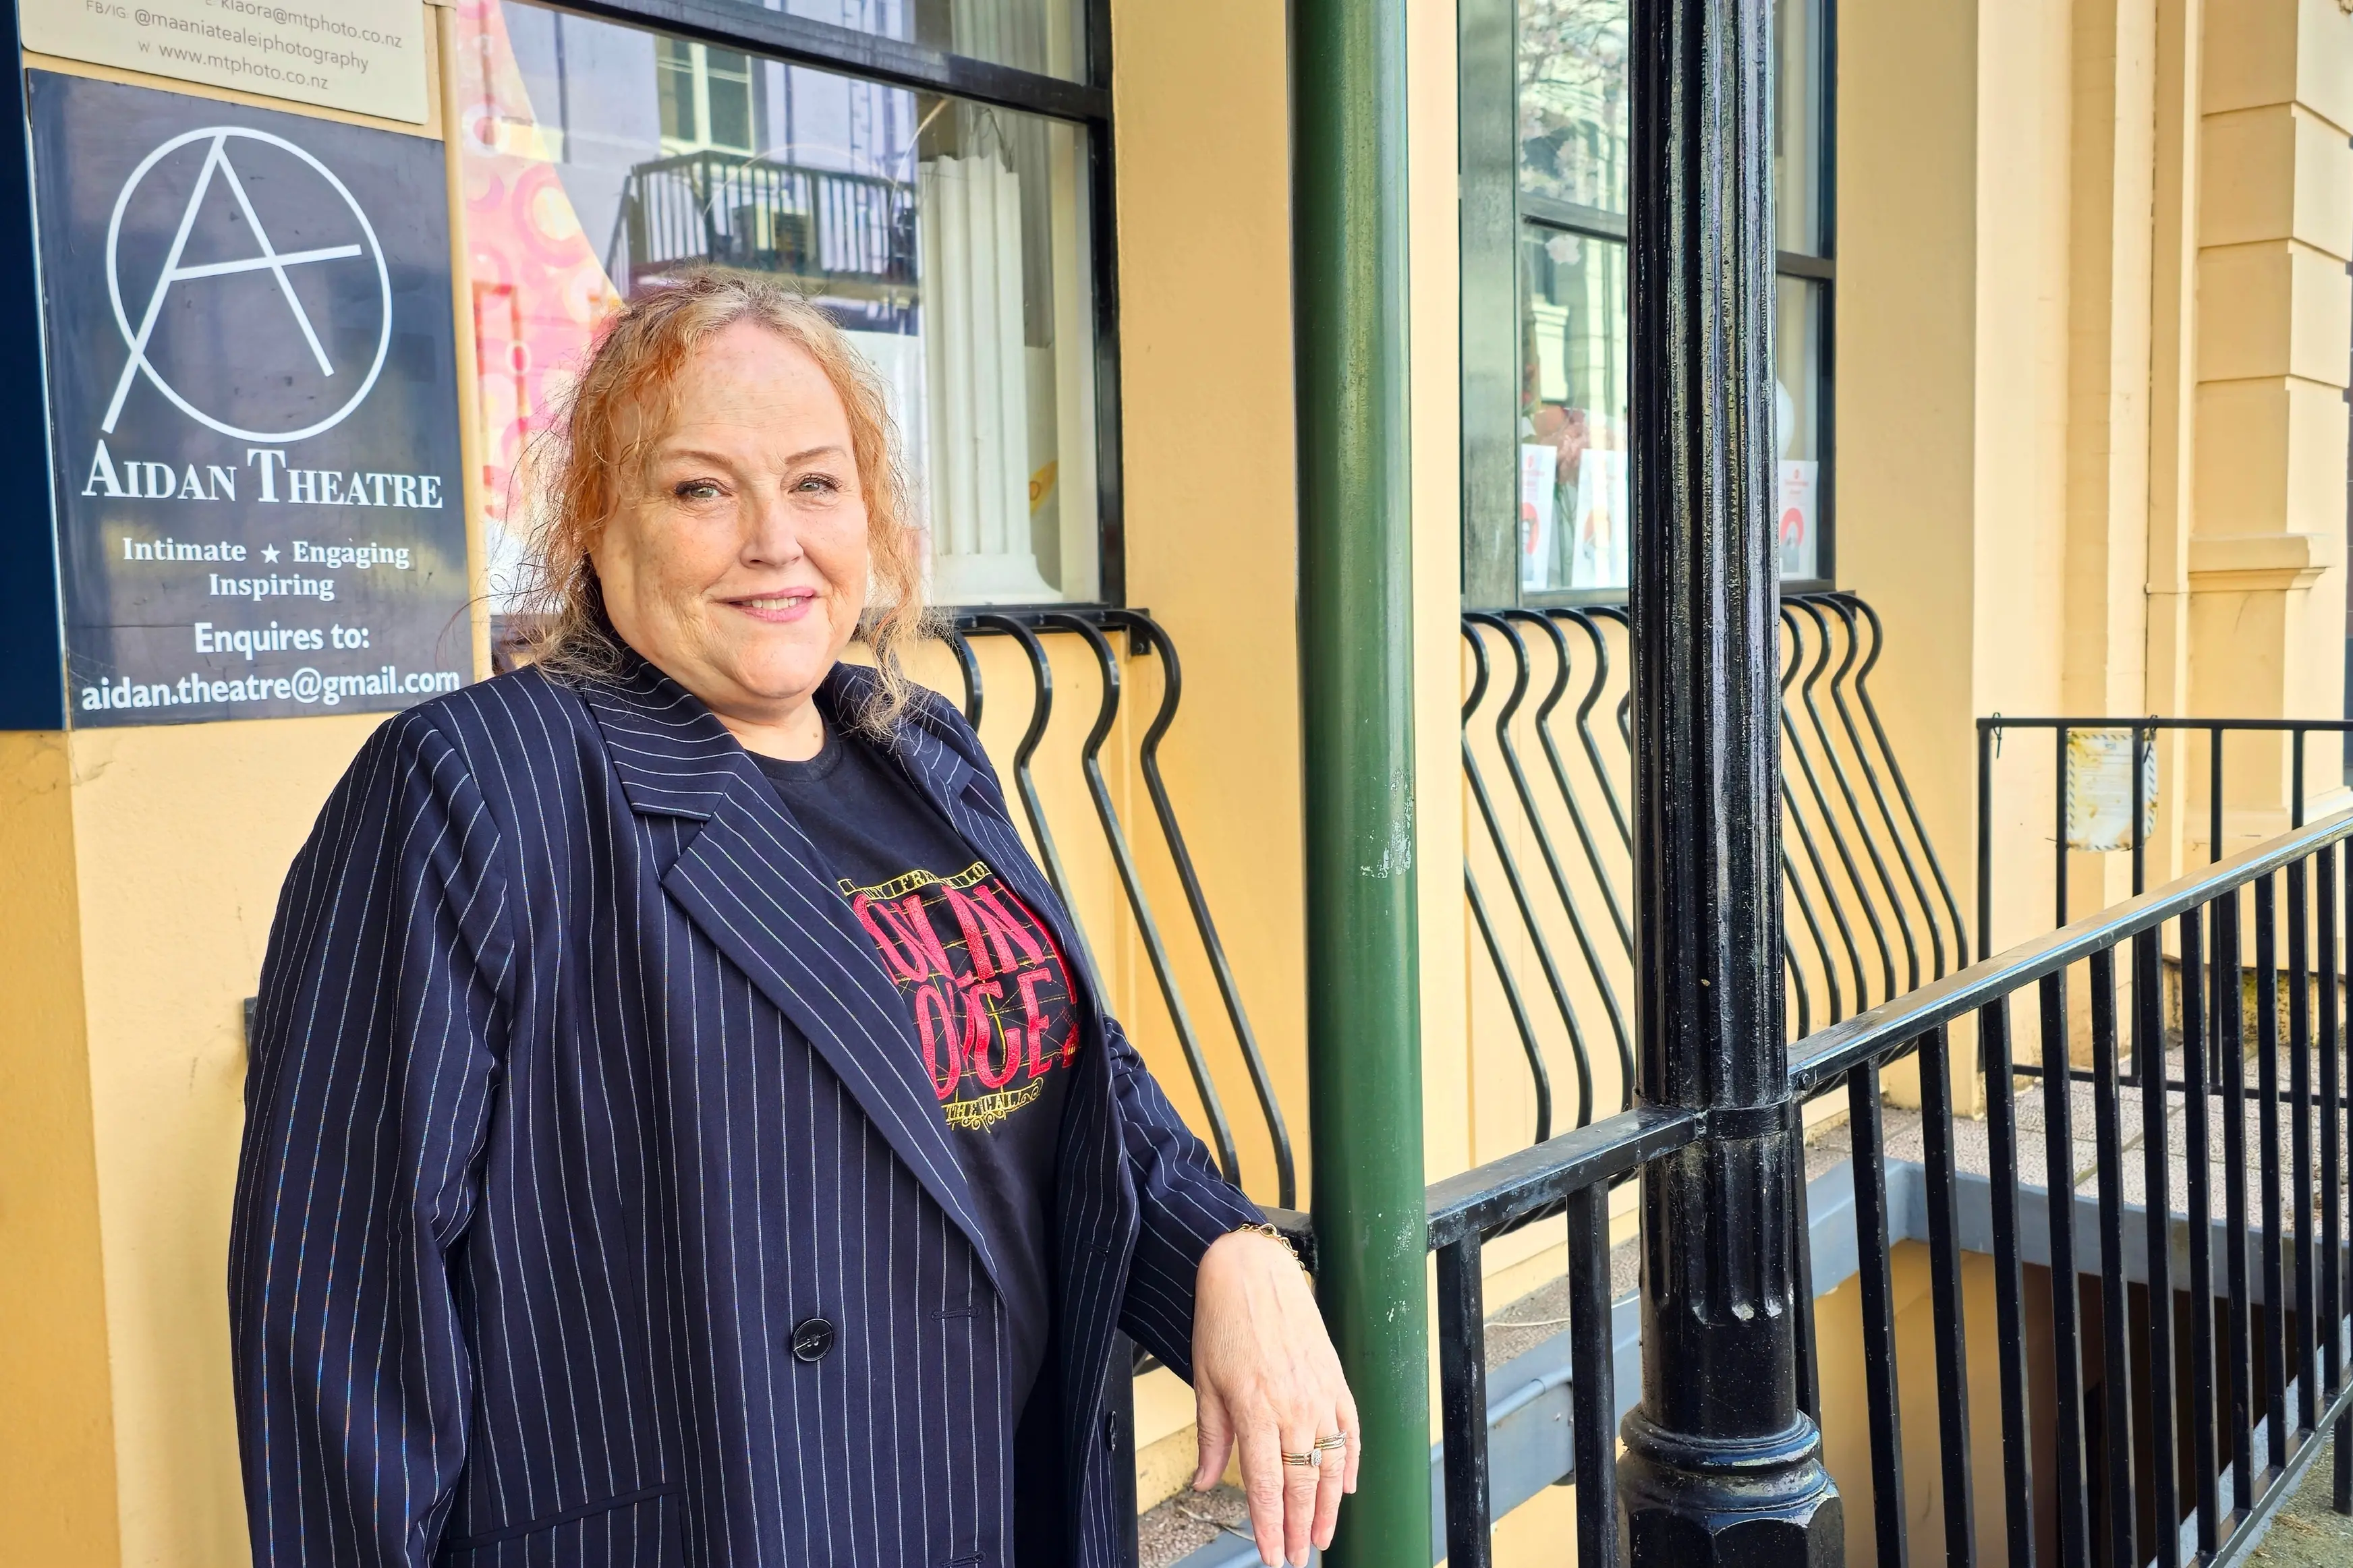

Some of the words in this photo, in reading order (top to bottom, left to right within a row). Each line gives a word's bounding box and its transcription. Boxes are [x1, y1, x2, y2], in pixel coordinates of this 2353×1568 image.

[134, 9, 369, 73] @maaniatealeiphotography
[159, 45, 329, 90] www.mtphoto.co.nz
[123, 538, 247, 562] Intimate
[293, 542, 410, 569] Engaging
[209, 574, 335, 602] Inspiring
[194, 620, 324, 661] Enquires
[331, 623, 370, 649] to:
[82, 666, 460, 712] aidan.theatre@gmail.com
